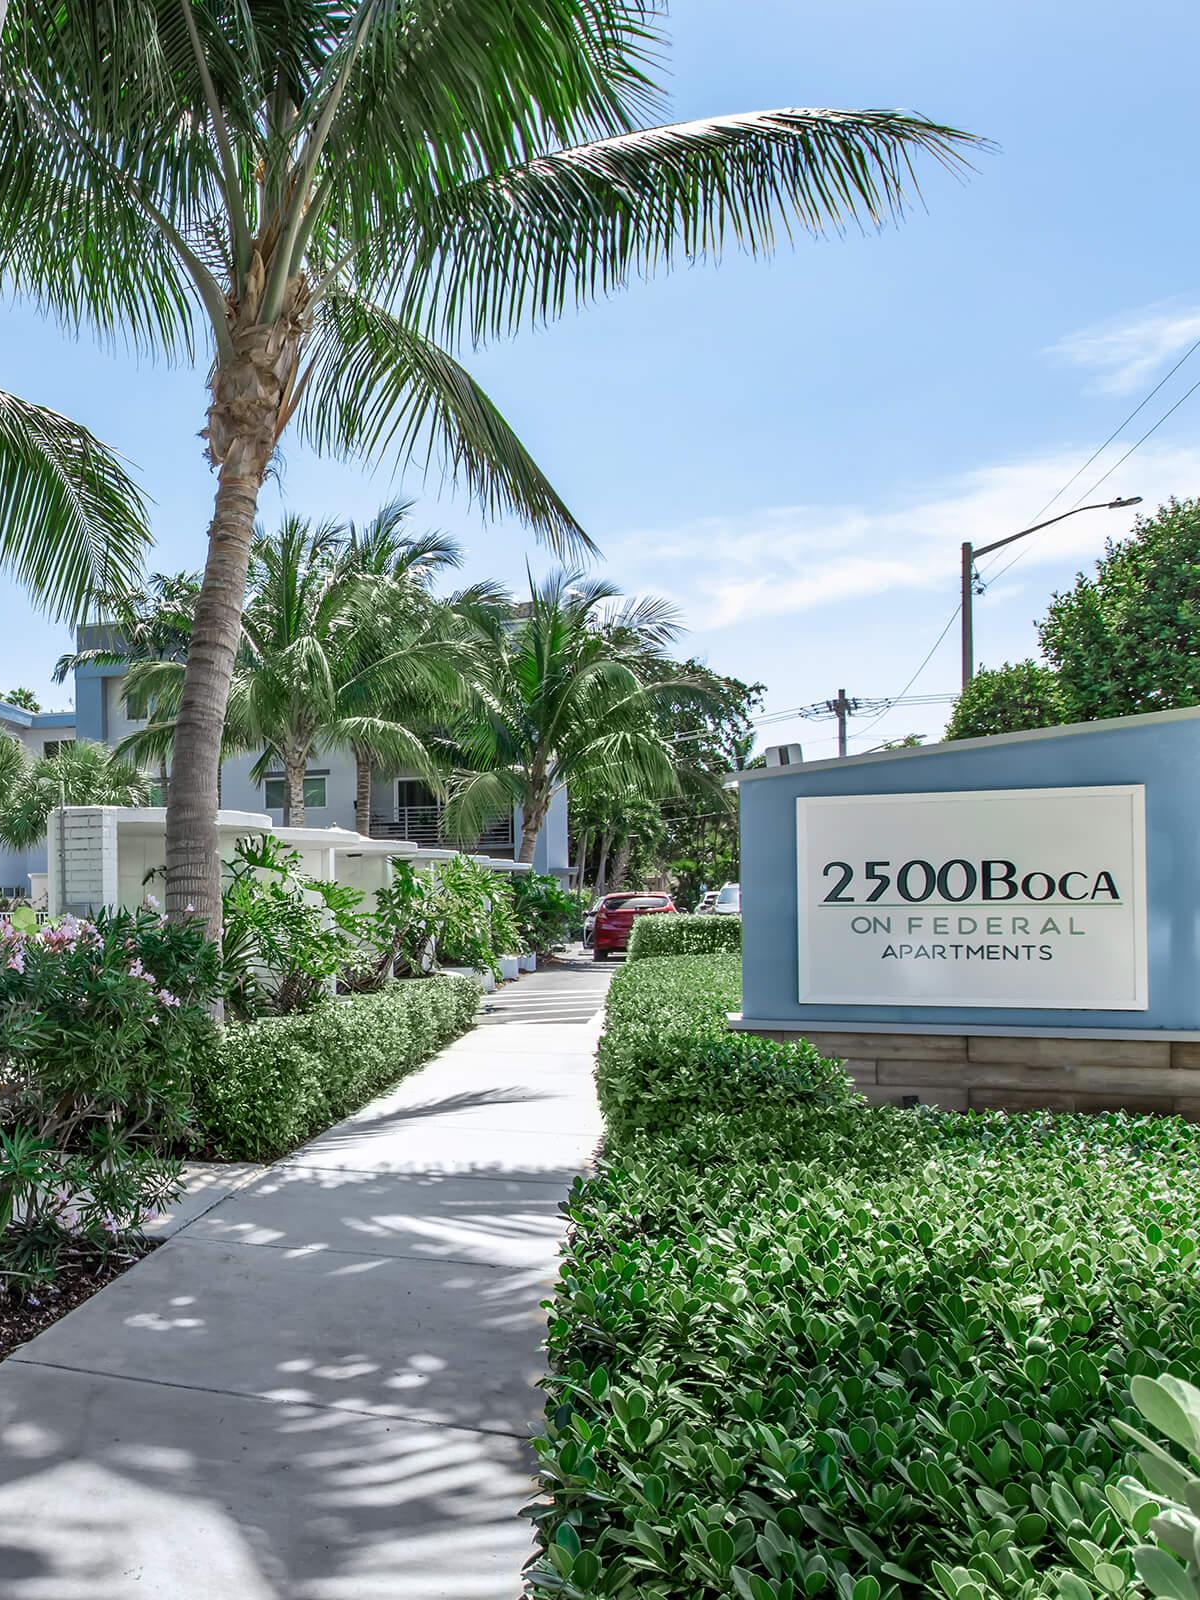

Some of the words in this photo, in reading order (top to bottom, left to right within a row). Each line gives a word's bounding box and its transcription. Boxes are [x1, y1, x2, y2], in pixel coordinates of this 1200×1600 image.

[851, 916, 892, 935] ON
[907, 916, 1086, 936] FEDERAL
[881, 944, 1053, 961] APARTMENTS
